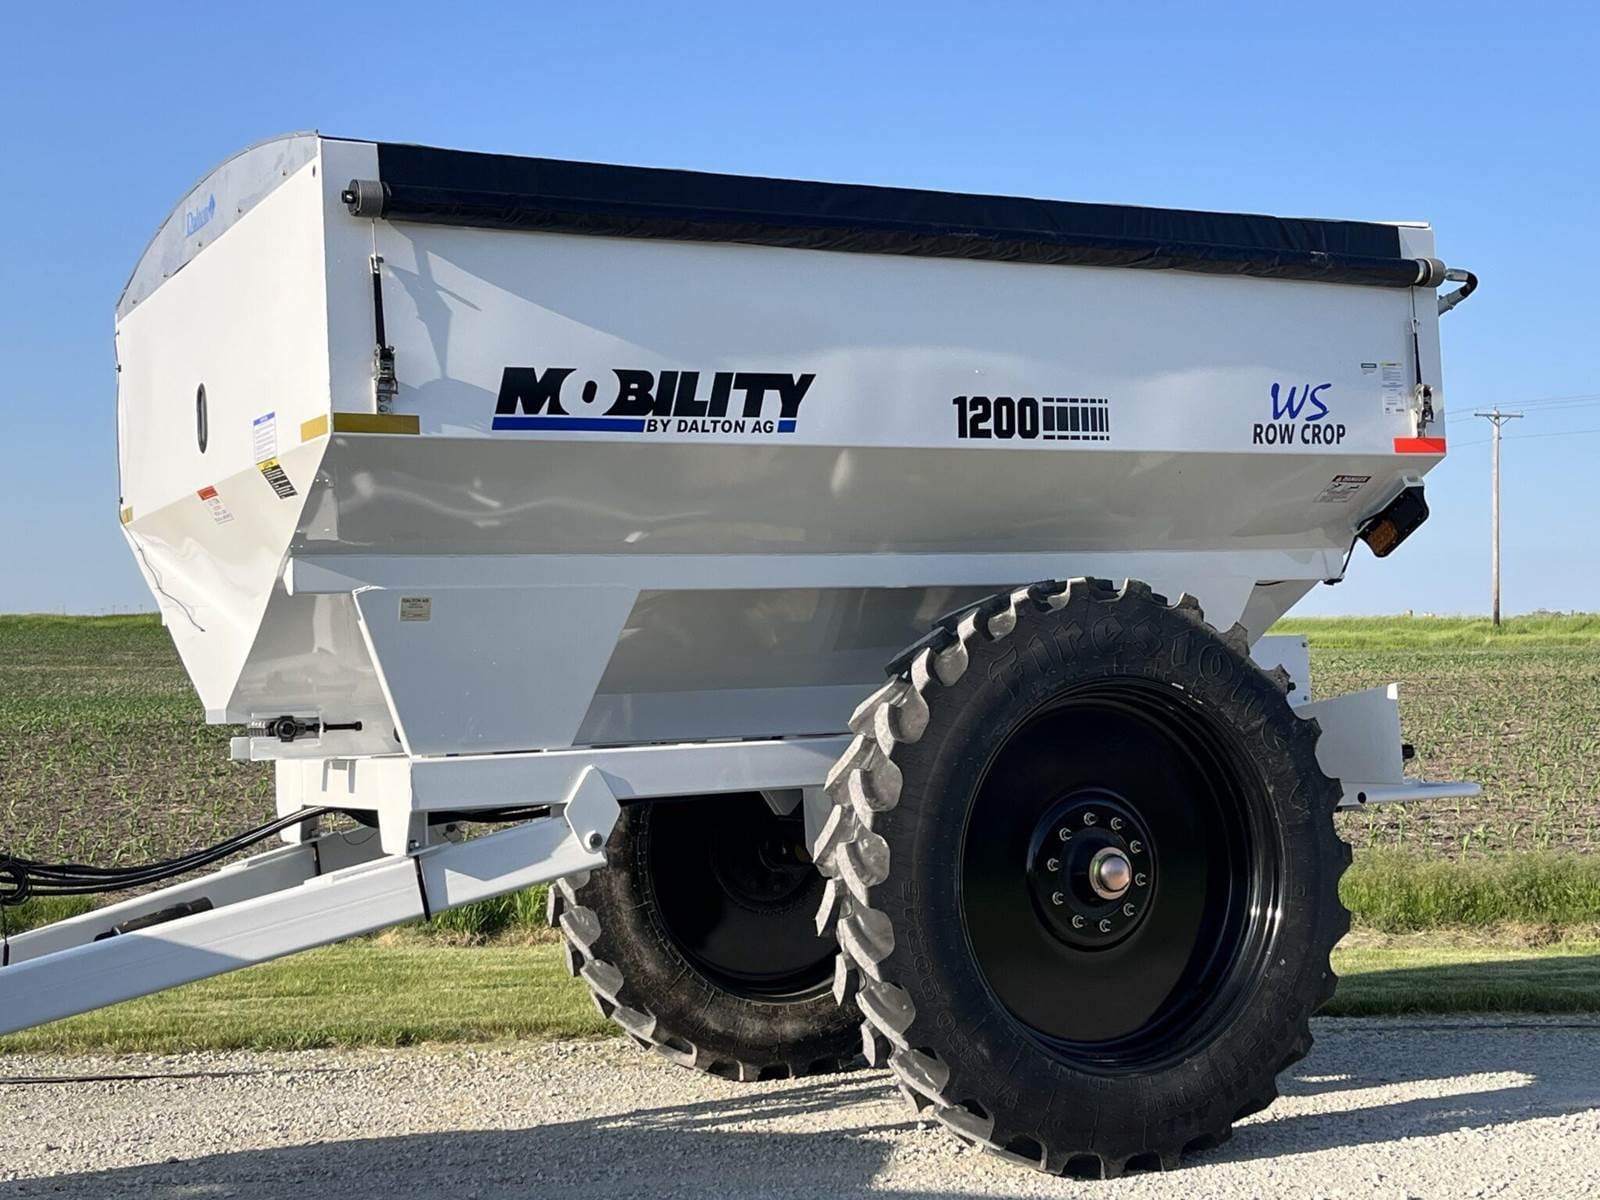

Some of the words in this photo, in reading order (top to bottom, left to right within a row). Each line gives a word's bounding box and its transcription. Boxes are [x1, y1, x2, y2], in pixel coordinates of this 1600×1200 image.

[494, 366, 817, 418] MOBILITY
[1271, 383, 1332, 421] WS
[646, 420, 671, 433] BY
[677, 420, 746, 433] DALTON
[751, 421, 774, 434] AG
[952, 396, 1039, 439] 1200
[1253, 424, 1295, 444] ROW
[1301, 424, 1346, 444] CROP
[986, 608, 1294, 752] Firestone
